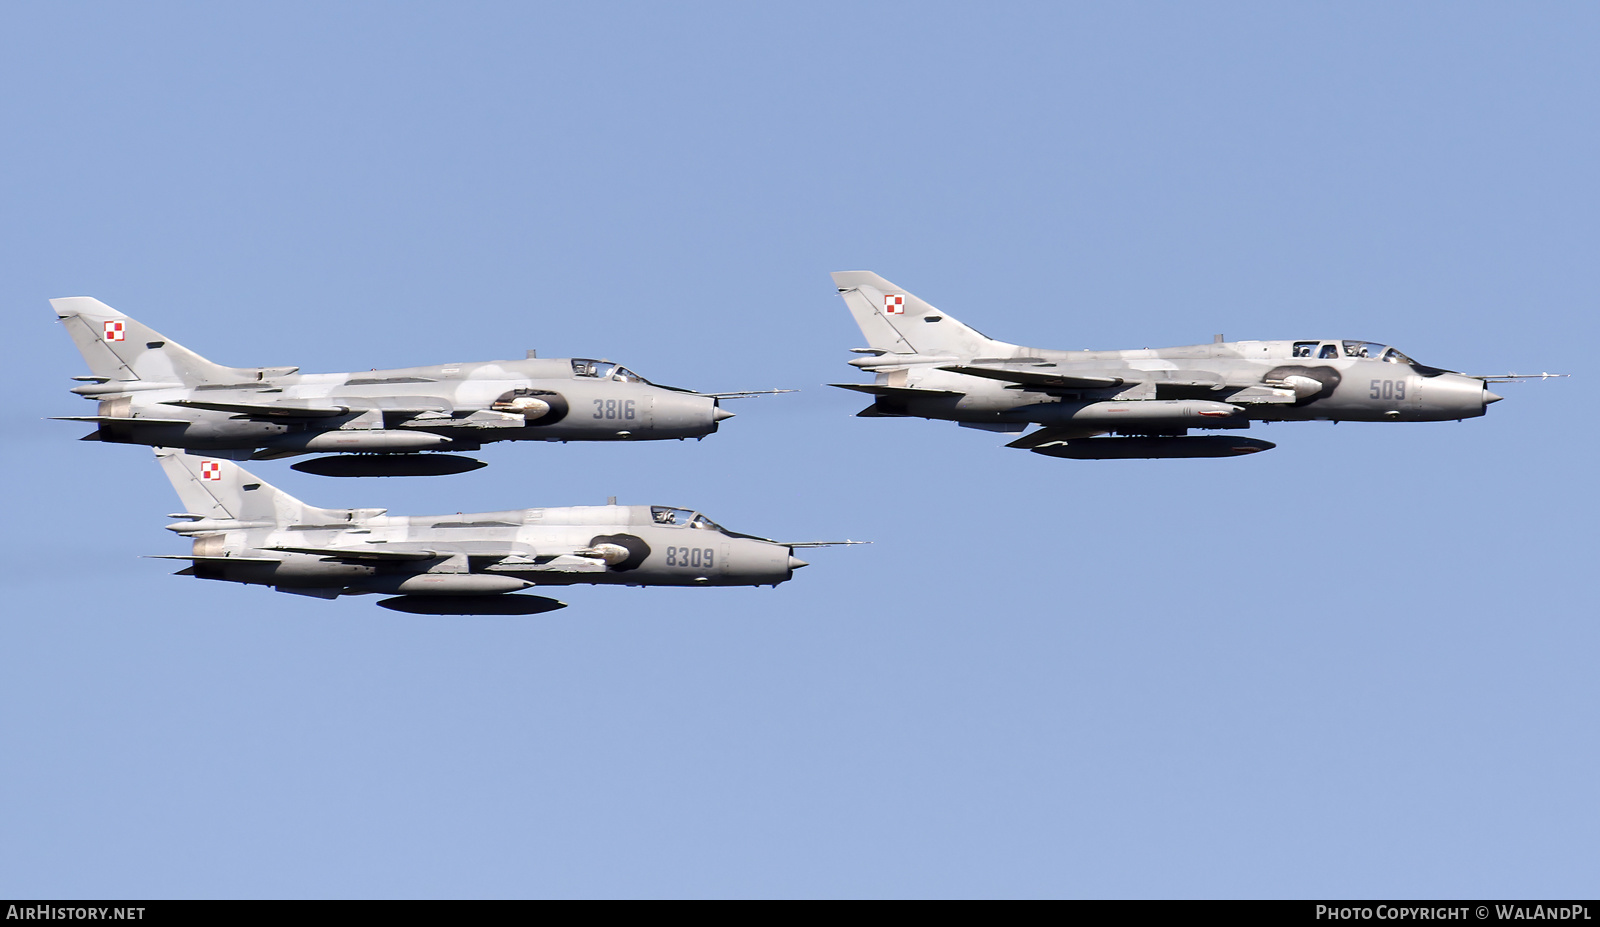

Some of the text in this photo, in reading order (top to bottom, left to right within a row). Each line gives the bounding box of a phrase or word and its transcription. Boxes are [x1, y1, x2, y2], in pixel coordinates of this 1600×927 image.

[1370, 379, 1406, 401] 509
[592, 399, 636, 421] 3816
[666, 546, 715, 569] 8309
